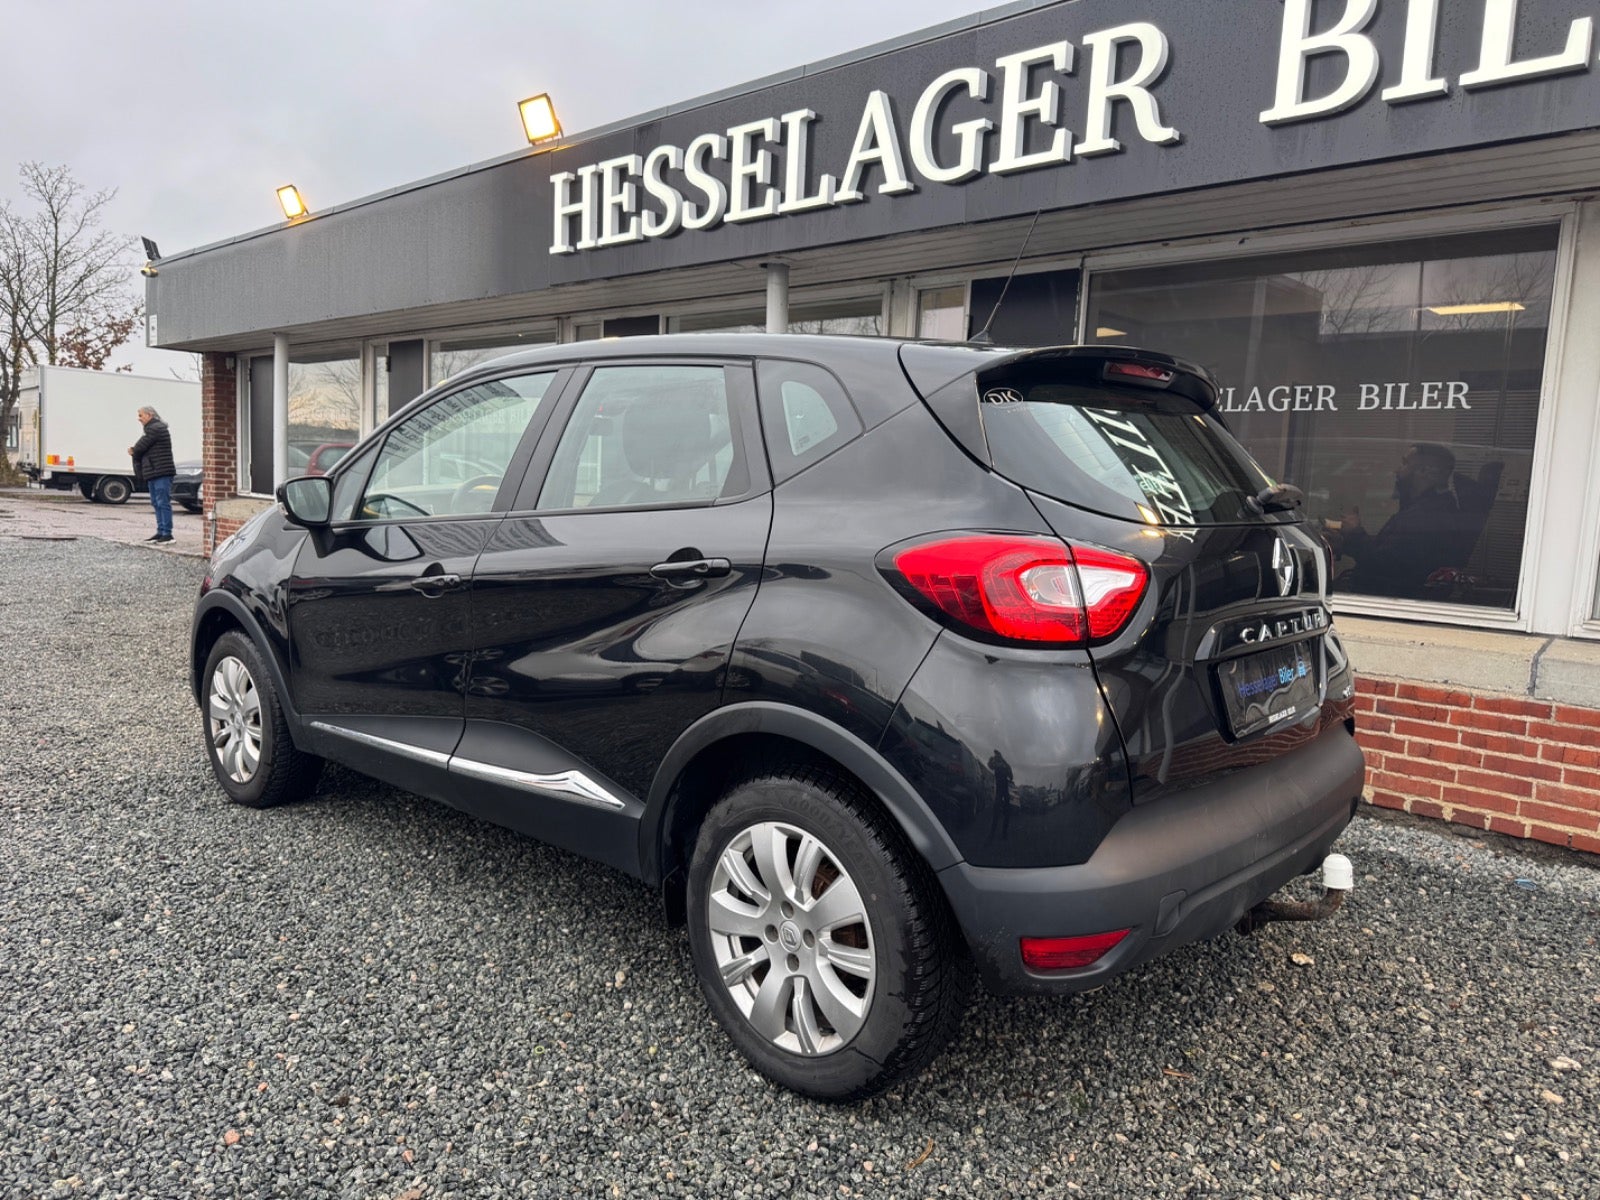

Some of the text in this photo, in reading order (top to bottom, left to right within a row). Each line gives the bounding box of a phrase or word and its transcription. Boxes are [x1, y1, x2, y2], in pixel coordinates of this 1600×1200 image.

[549, 0, 1600, 254] HESSELAGER BIL
[987, 390, 1019, 405] DK
[1357, 381, 1471, 410] BILER
[1240, 612, 1322, 644] CAPTUR
